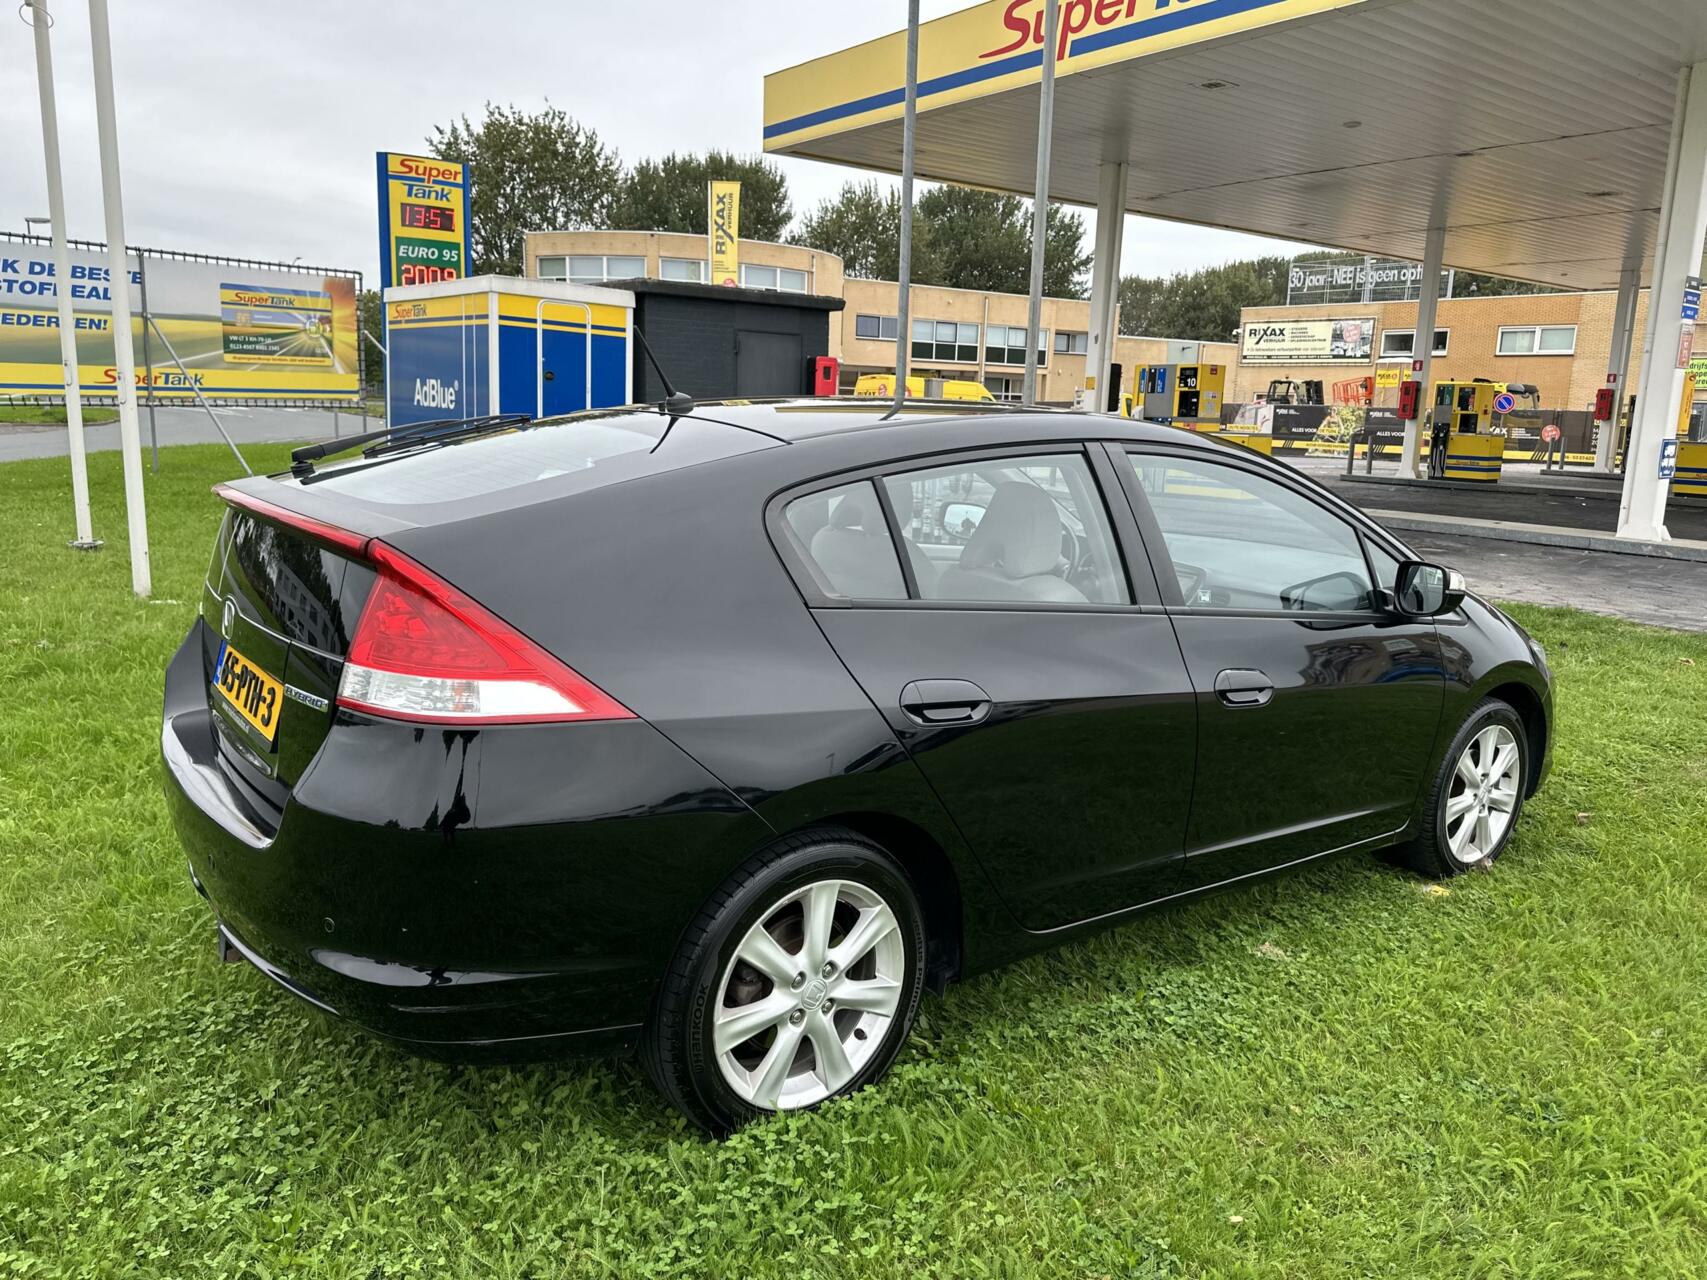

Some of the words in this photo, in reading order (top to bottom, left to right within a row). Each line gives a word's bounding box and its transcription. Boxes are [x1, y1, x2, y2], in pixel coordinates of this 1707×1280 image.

[388, 158, 462, 184] Super
[402, 183, 452, 202] Tank
[405, 206, 455, 230] 13:57
[398, 245, 439, 260] EURO
[442, 249, 459, 262] 95
[71, 265, 142, 285] BESE
[1290, 271, 1304, 288] 30
[1304, 272, 1327, 292] jaar
[1333, 268, 1355, 285] NEE
[1356, 266, 1366, 284] is
[1368, 269, 1398, 288] geen
[231, 292, 297, 307] SuperTank
[1248, 327, 1286, 345] RIXAX
[94, 368, 204, 386] SperTank
[1186, 378, 1196, 387] 10
[221, 651, 276, 728] 65-PTH-3
